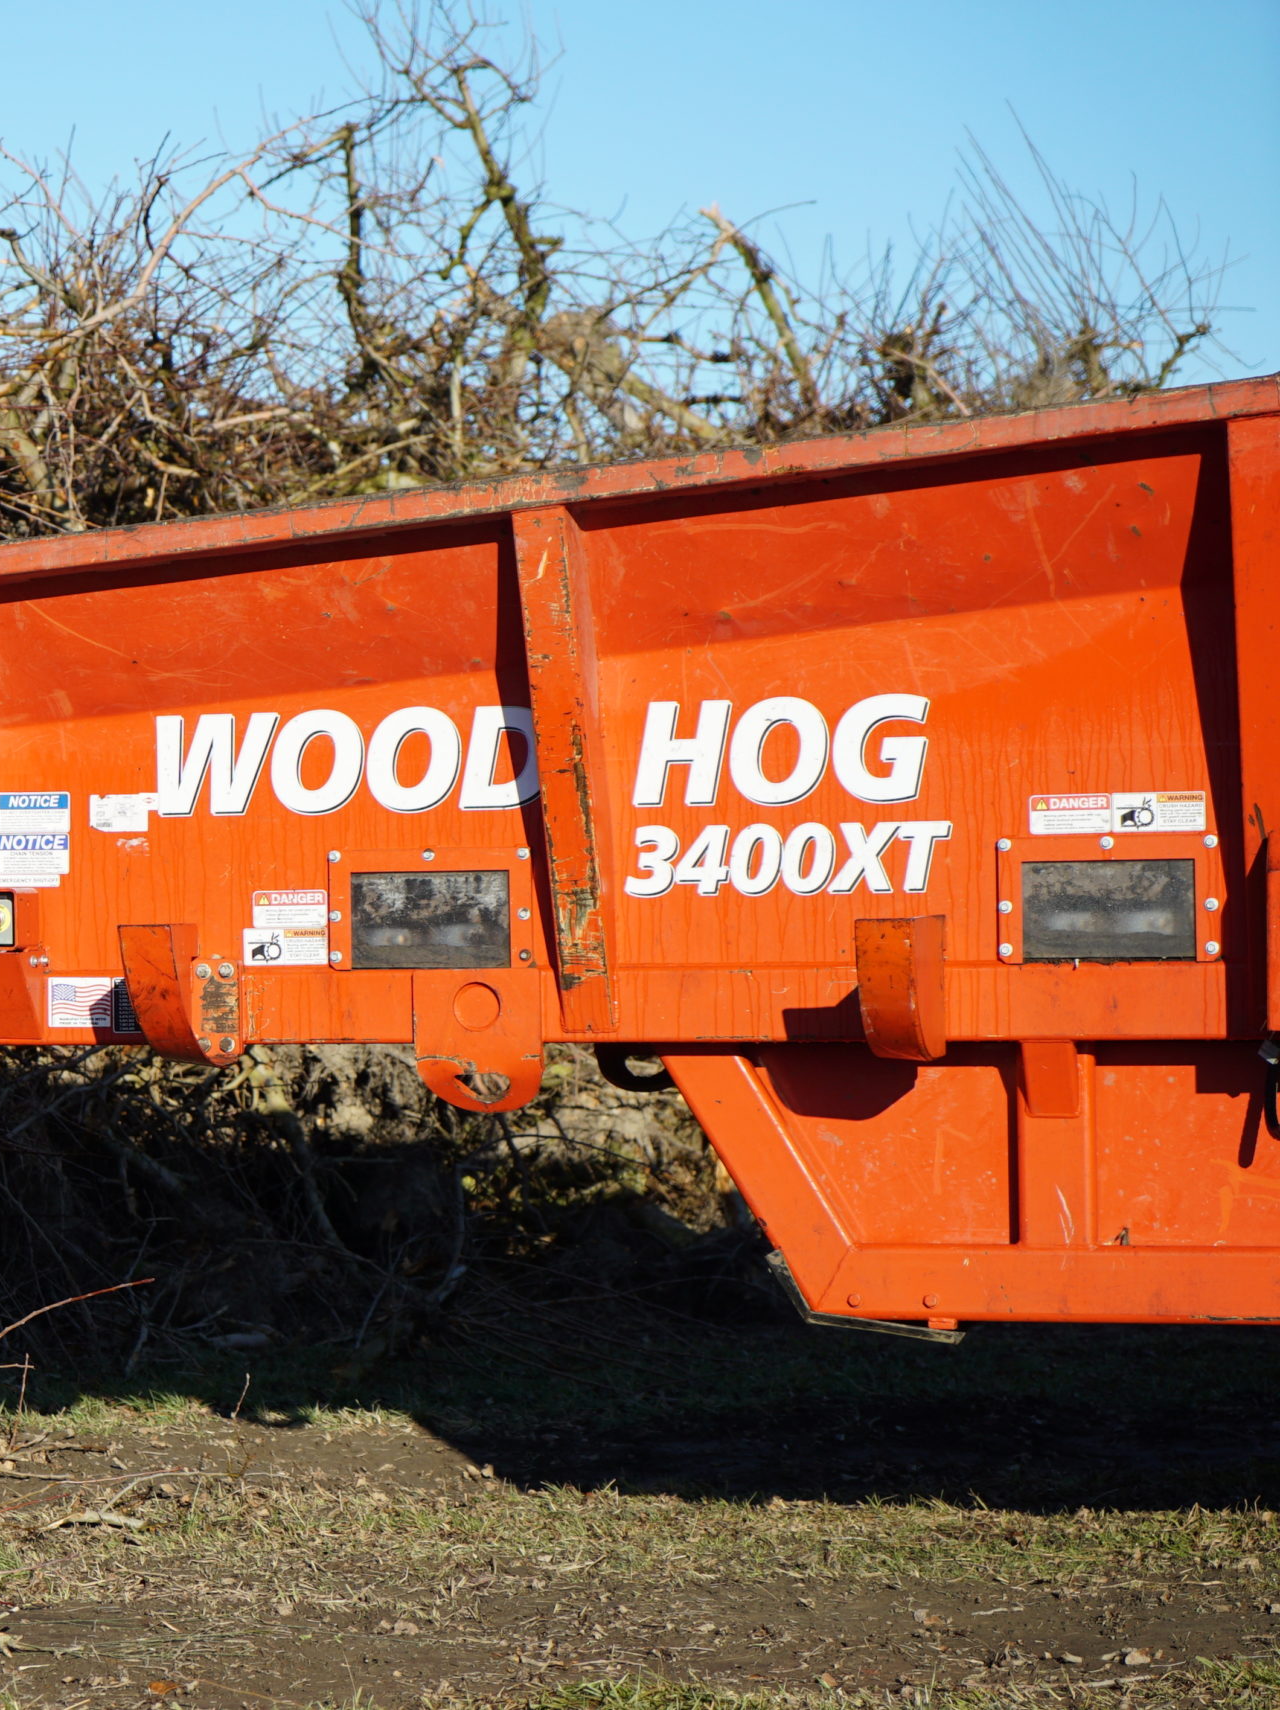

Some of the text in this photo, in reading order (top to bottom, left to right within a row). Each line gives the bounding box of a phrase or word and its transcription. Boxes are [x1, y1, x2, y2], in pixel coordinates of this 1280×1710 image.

[156, 693, 930, 817] WOOD HOG
[8, 795, 60, 808] NOTICE
[1050, 797, 1107, 809] DANGER
[0, 835, 66, 850] NOTICE
[624, 820, 952, 897] 3400XT
[271, 893, 323, 904] DANGER
